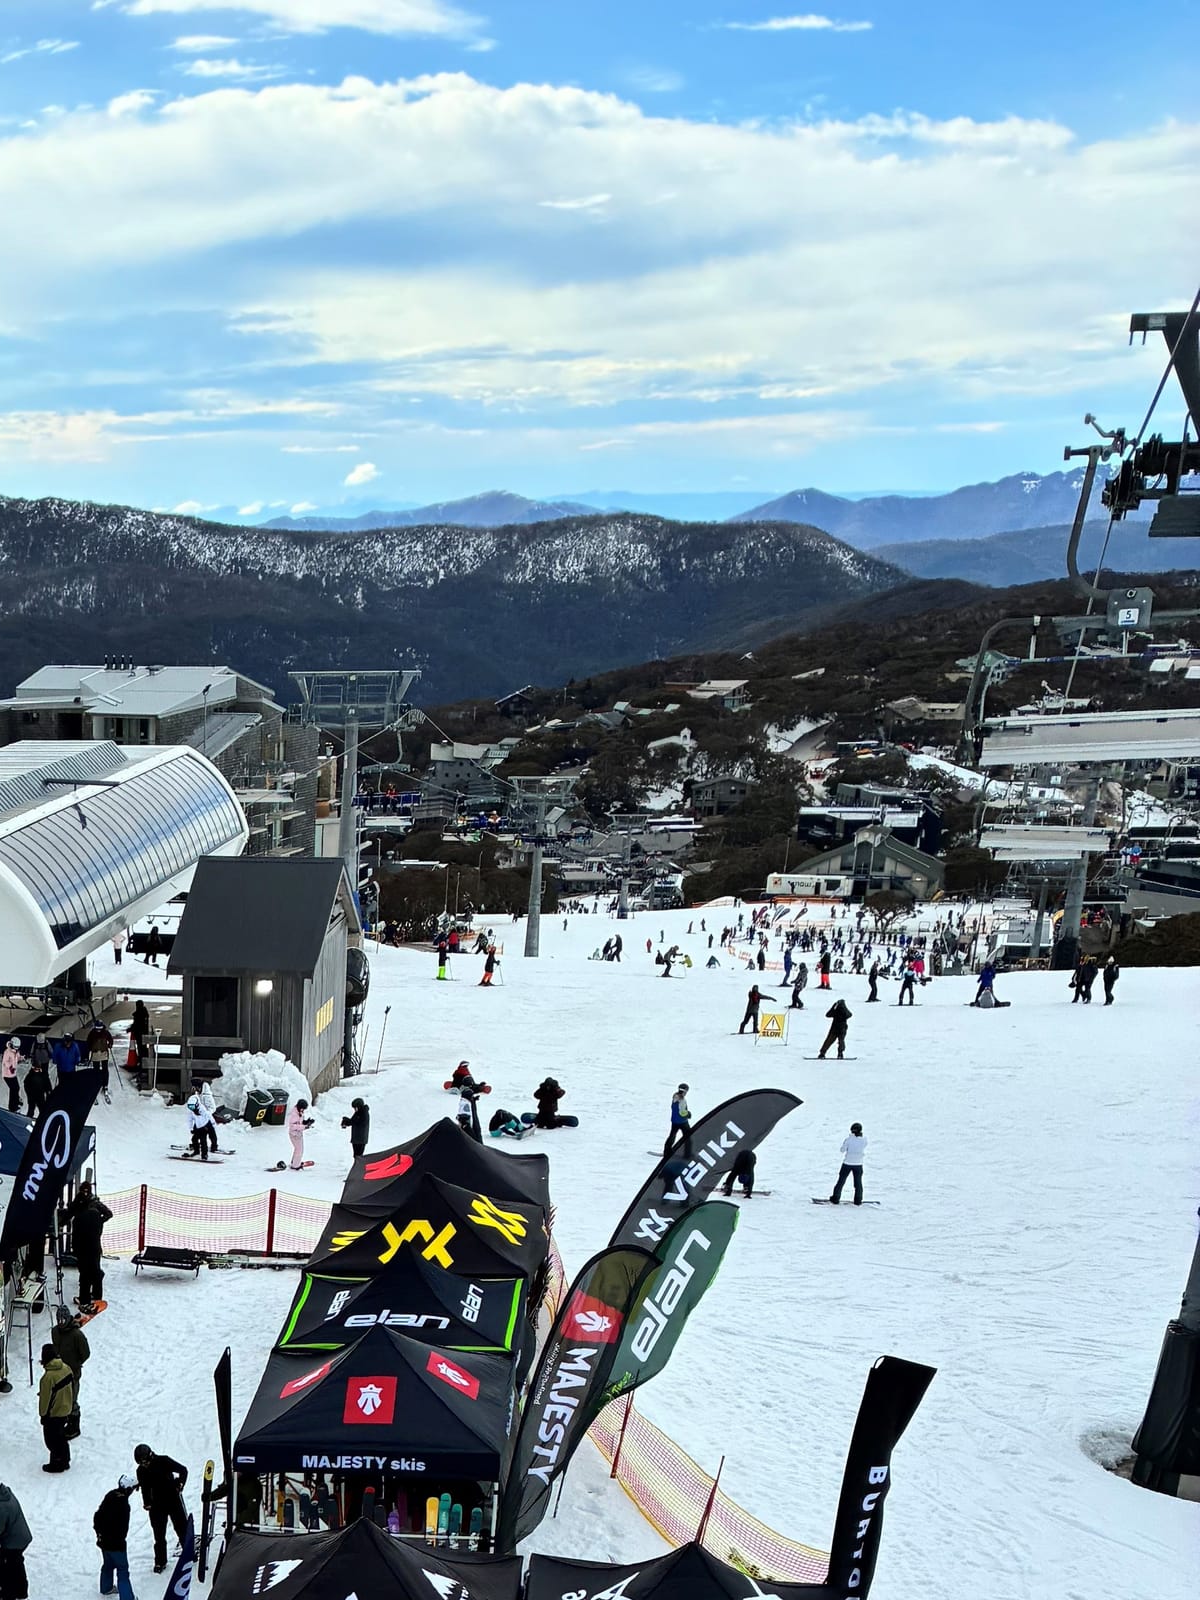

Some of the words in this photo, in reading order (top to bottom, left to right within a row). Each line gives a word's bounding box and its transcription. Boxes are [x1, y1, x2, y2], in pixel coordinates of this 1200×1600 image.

[460, 1284, 484, 1323] elan
[631, 1229, 711, 1363] elan
[344, 1309, 450, 1329] elan
[528, 1347, 598, 1485] MAJESTY
[302, 1454, 387, 1469] MAJESTY
[390, 1457, 427, 1471] skis
